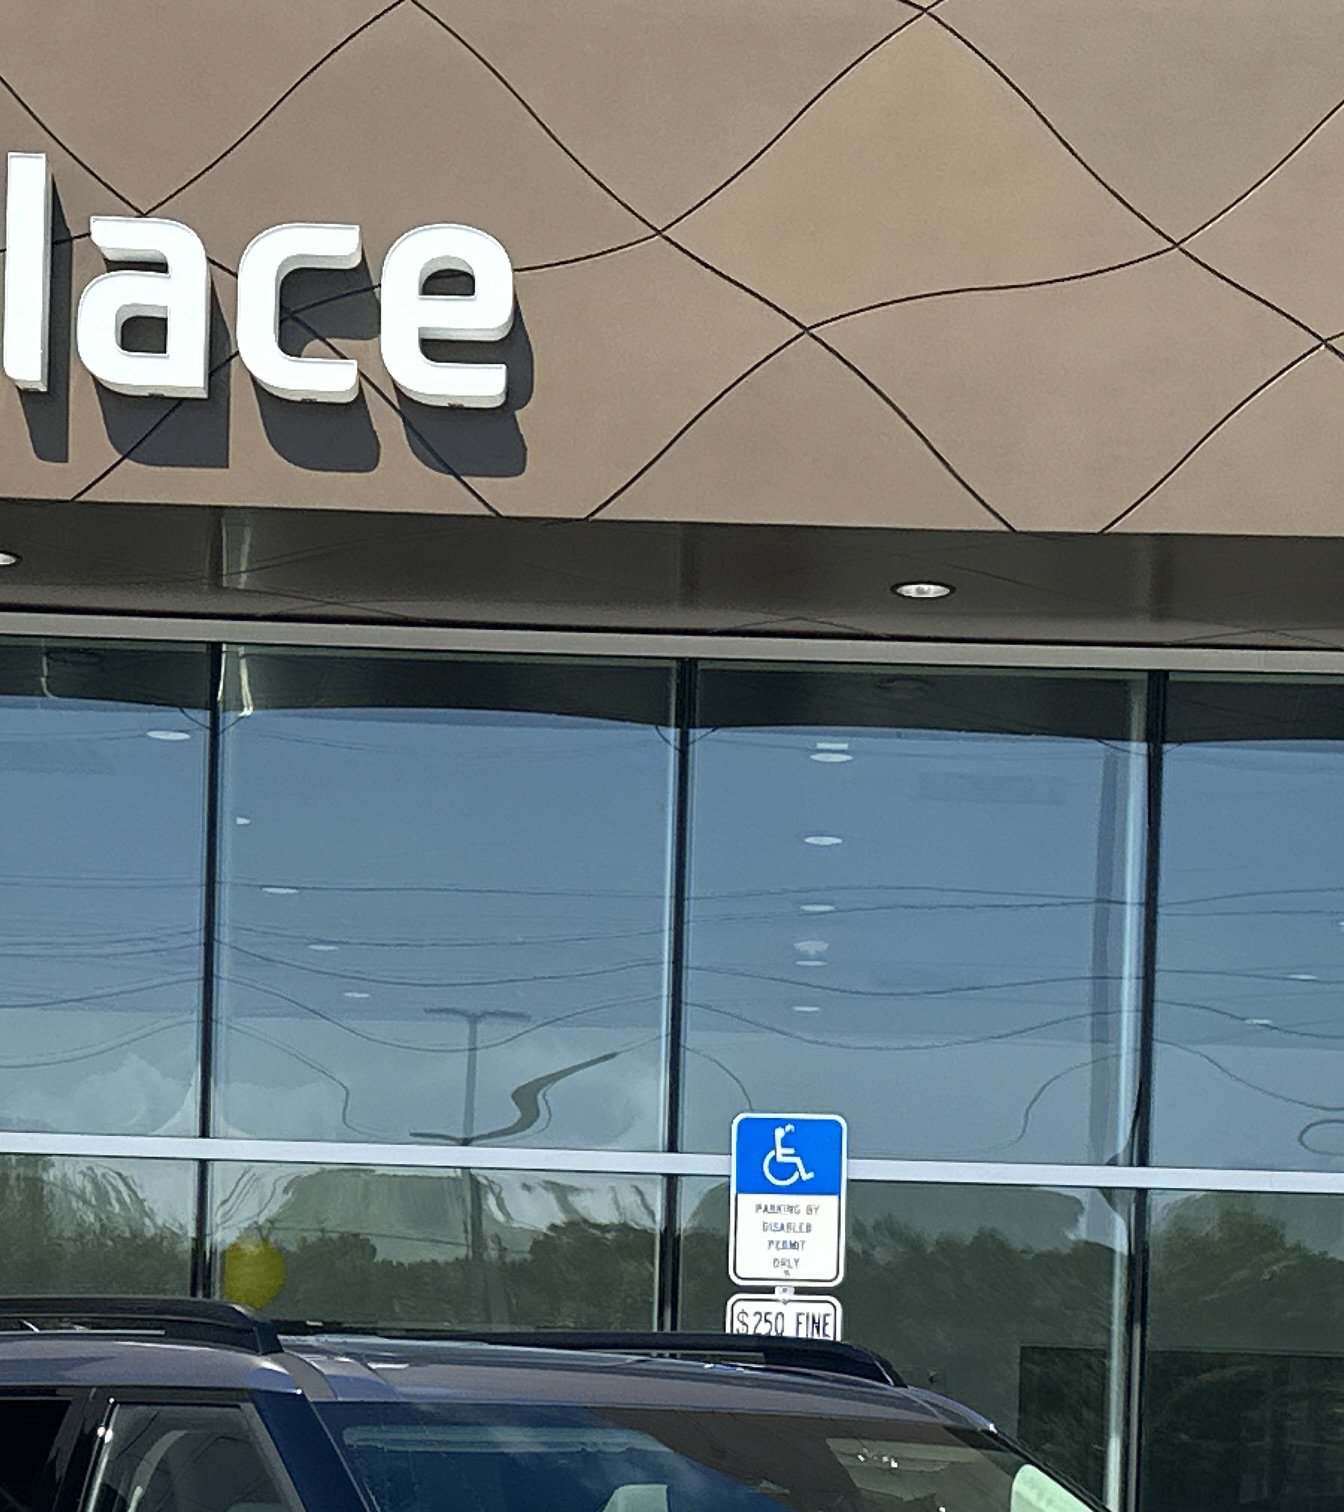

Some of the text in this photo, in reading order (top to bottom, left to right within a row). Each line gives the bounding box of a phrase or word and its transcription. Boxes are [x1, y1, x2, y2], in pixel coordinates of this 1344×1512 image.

[755, 1204, 821, 1216] PARKING BY
[762, 1221, 812, 1233] DISABLED
[767, 1239, 806, 1251] PERMIT
[772, 1257, 800, 1269] ONLY
[736, 1308, 832, 1339] $250 FINE
